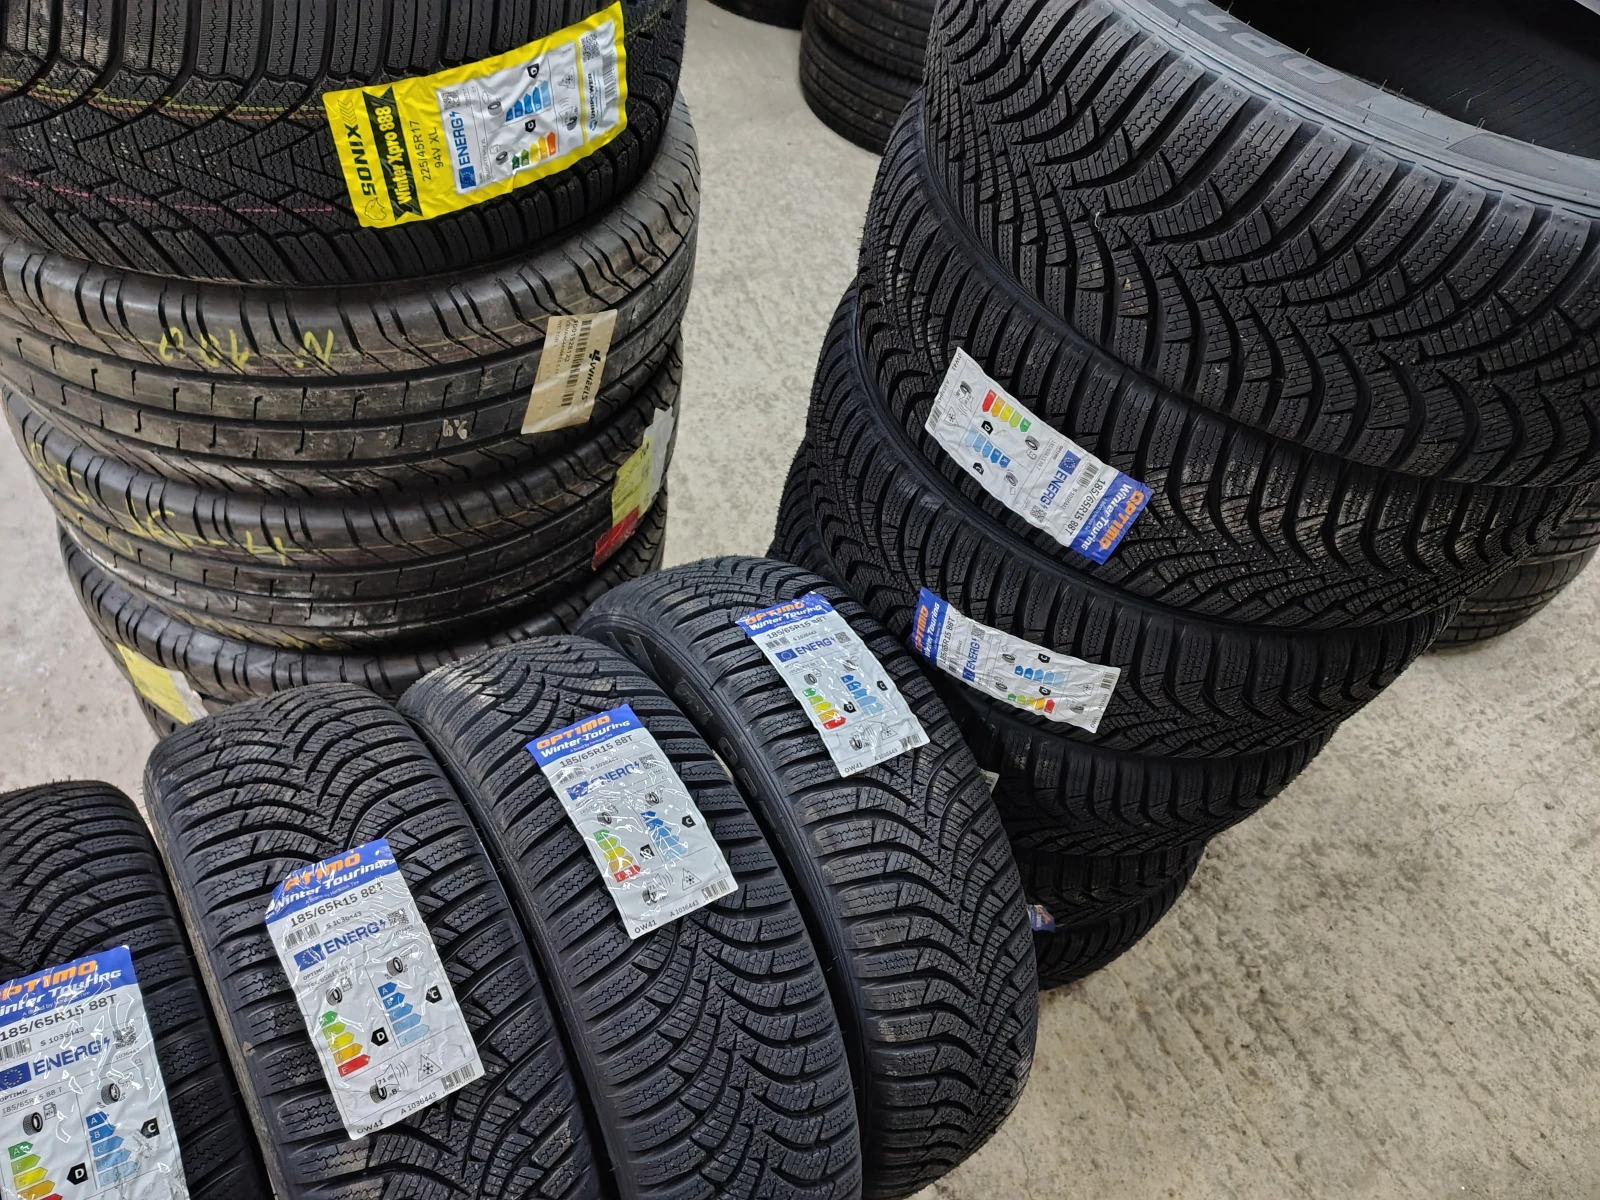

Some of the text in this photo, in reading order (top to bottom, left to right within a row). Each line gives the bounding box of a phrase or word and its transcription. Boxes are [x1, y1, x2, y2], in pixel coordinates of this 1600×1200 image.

[587, 72, 596, 119] UNIPOWER
[375, 105, 413, 205] Winter Xpro 888
[409, 120, 432, 182] 225/45R17
[428, 126, 444, 169] 94V XL
[450, 117, 471, 167] ENERG
[344, 123, 377, 196] SONIX
[1040, 470, 1068, 506] ENERG
[1074, 478, 1106, 520] 185/65R15
[1104, 484, 1132, 516] Winter
[1065, 520, 1079, 536] 88T
[1080, 516, 1110, 550] Touring
[748, 616, 783, 631] Winter
[782, 604, 823, 620] Touring
[766, 621, 812, 640] 185/65R15
[926, 602, 940, 636] Touring
[946, 616, 956, 631] 88T
[795, 638, 832, 655] ENERG
[924, 636, 933, 658] Winter
[966, 641, 980, 671] ENERG
[540, 720, 630, 758] Winter Touring
[559, 734, 634, 768] 185/65R15 88T
[844, 762, 864, 773] OW41
[274, 886, 321, 910] Winter
[290, 882, 384, 928] 185/65R15 88T
[323, 922, 380, 955] ENERG
[634, 919, 658, 934] OW41
[0, 994, 46, 1016] inter
[0, 1004, 85, 1041] 185/65R15
[88, 994, 117, 1011] 88T
[376, 1032, 385, 1042] D
[33, 1040, 102, 1076] ENERG
[378, 1078, 387, 1086] 71
[146, 1123, 156, 1133] C
[356, 1120, 384, 1134] OW41
[74, 1168, 85, 1179] D
